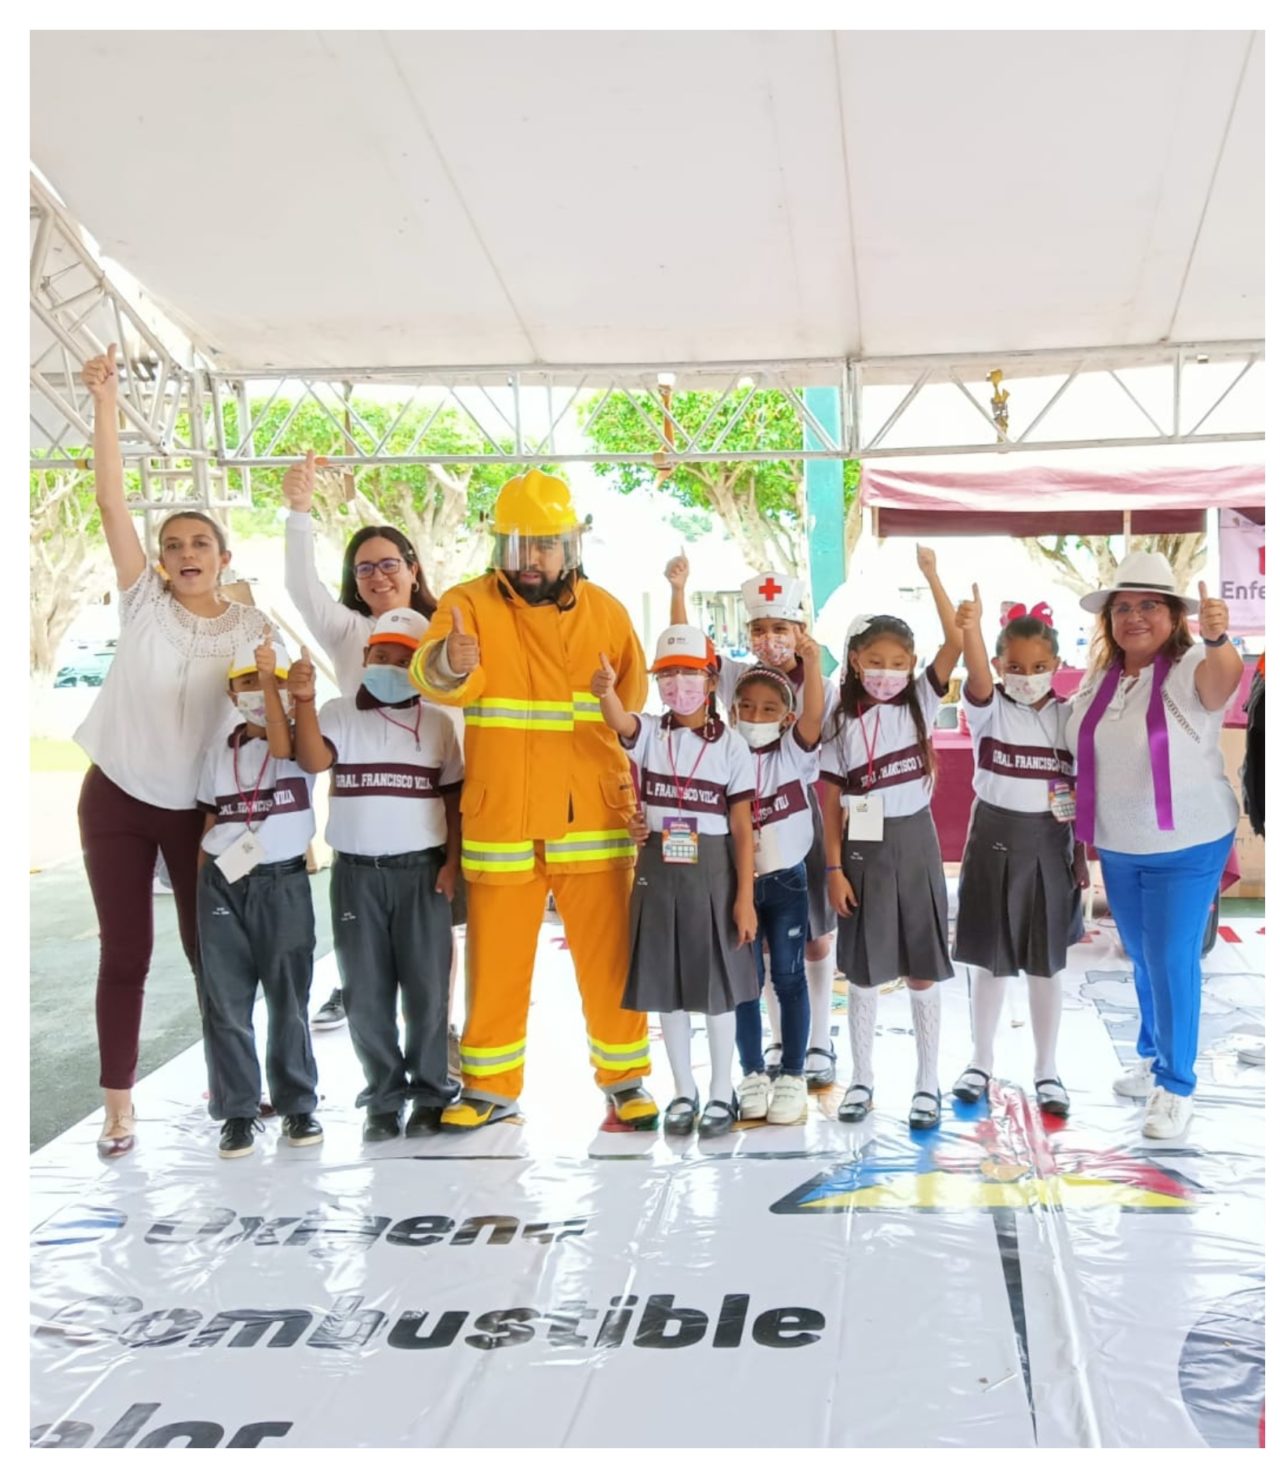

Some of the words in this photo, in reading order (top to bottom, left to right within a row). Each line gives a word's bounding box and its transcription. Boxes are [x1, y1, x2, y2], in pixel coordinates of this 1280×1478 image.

[1221, 580, 1265, 600] Enfe
[361, 772, 413, 789] FRANCISCO
[34, 1295, 826, 1349] Combustible
